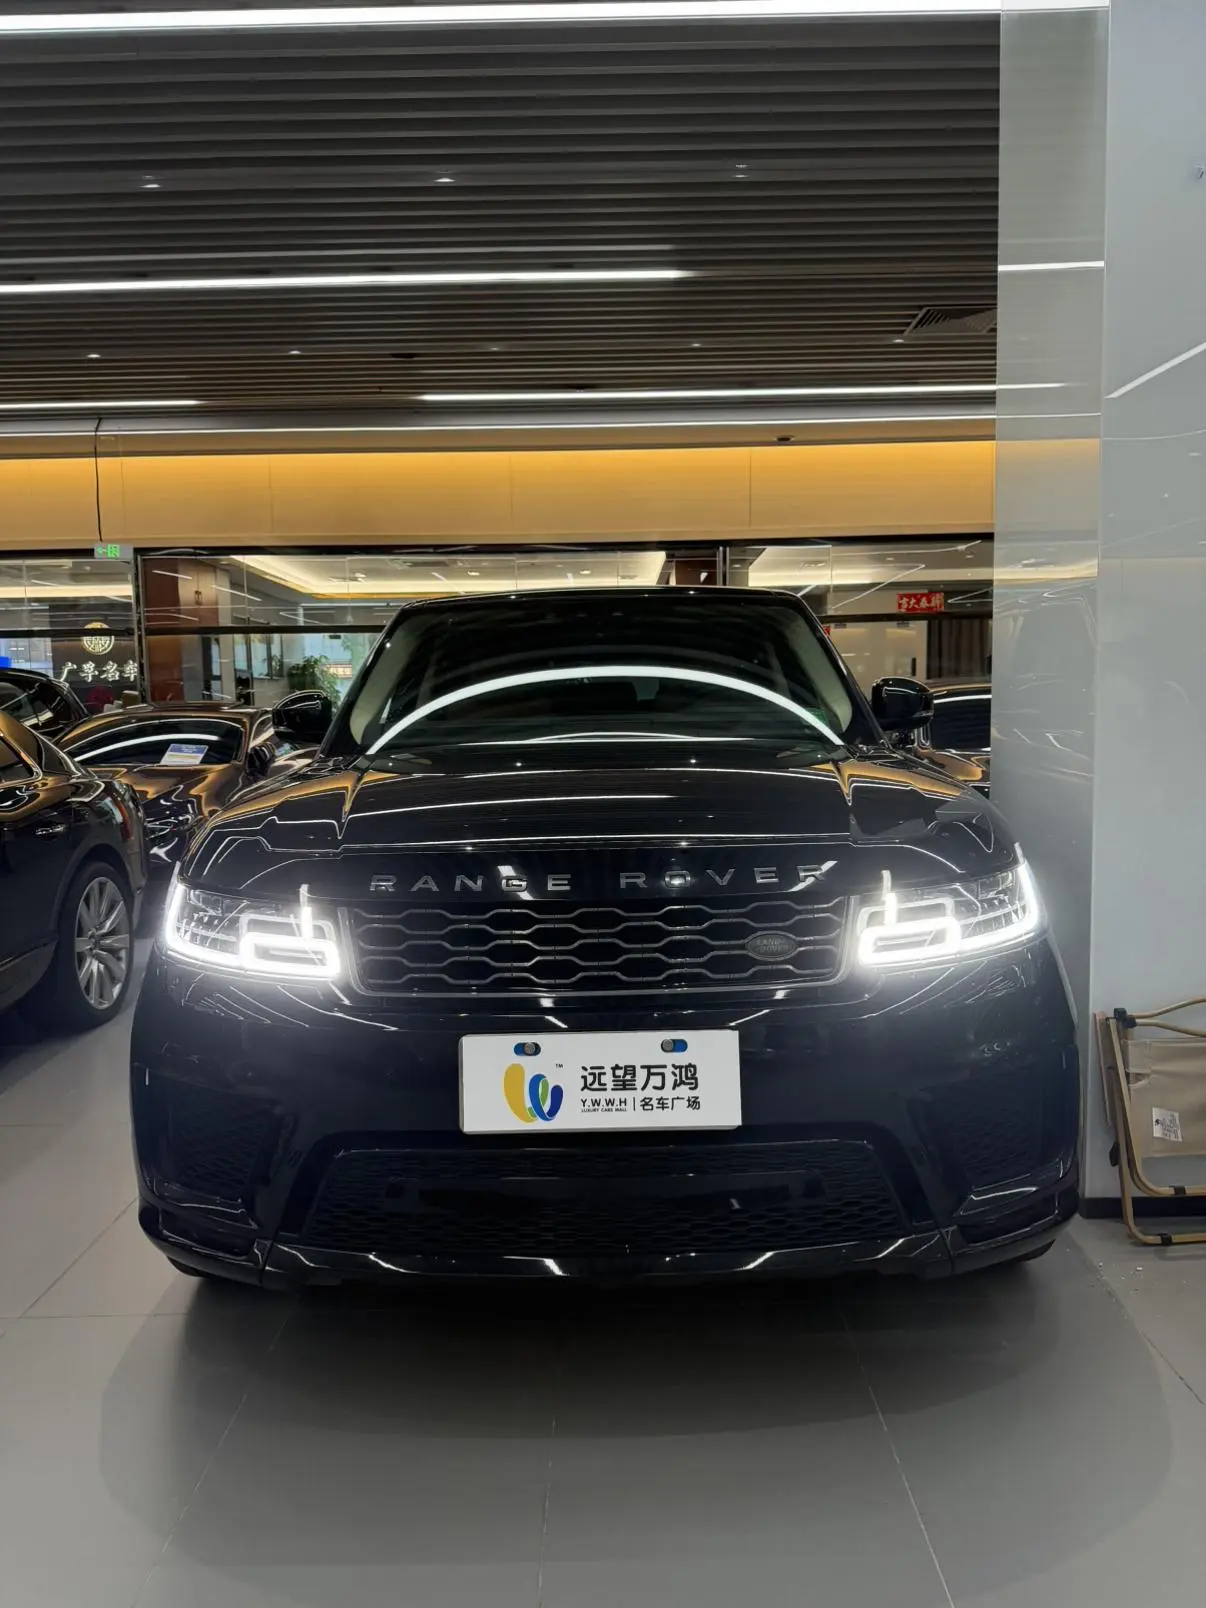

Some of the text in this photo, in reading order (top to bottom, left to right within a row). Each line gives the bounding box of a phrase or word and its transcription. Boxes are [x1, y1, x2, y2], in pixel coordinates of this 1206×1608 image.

[369, 864, 826, 893] RANGE ROVER
[580, 1062, 699, 1091] 远望万鸿
[580, 1096, 700, 1111] Y.W.W.H 名车广场
